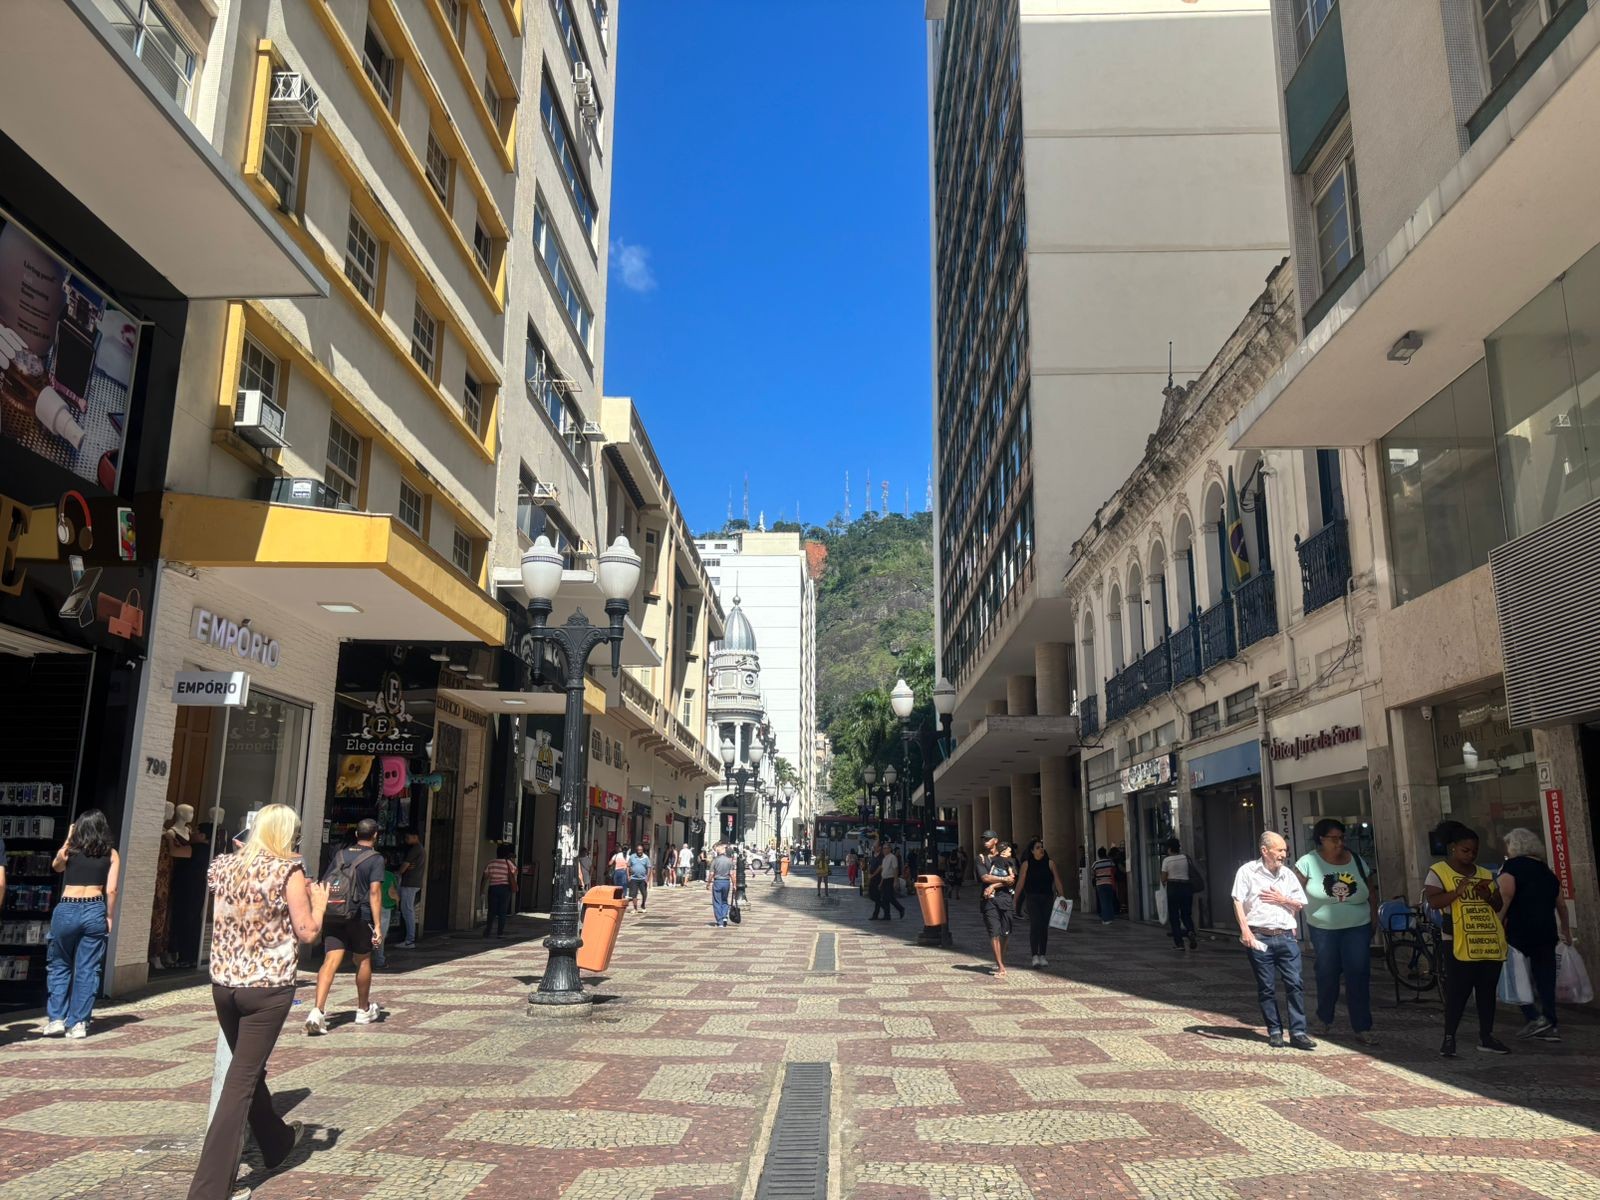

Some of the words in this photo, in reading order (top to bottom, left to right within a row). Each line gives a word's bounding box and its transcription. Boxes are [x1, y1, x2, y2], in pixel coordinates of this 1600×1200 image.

[376, 718, 387, 732] E
[1317, 730, 1332, 750] de
[1332, 725, 1361, 745] Fora
[146, 757, 167, 776] 799
